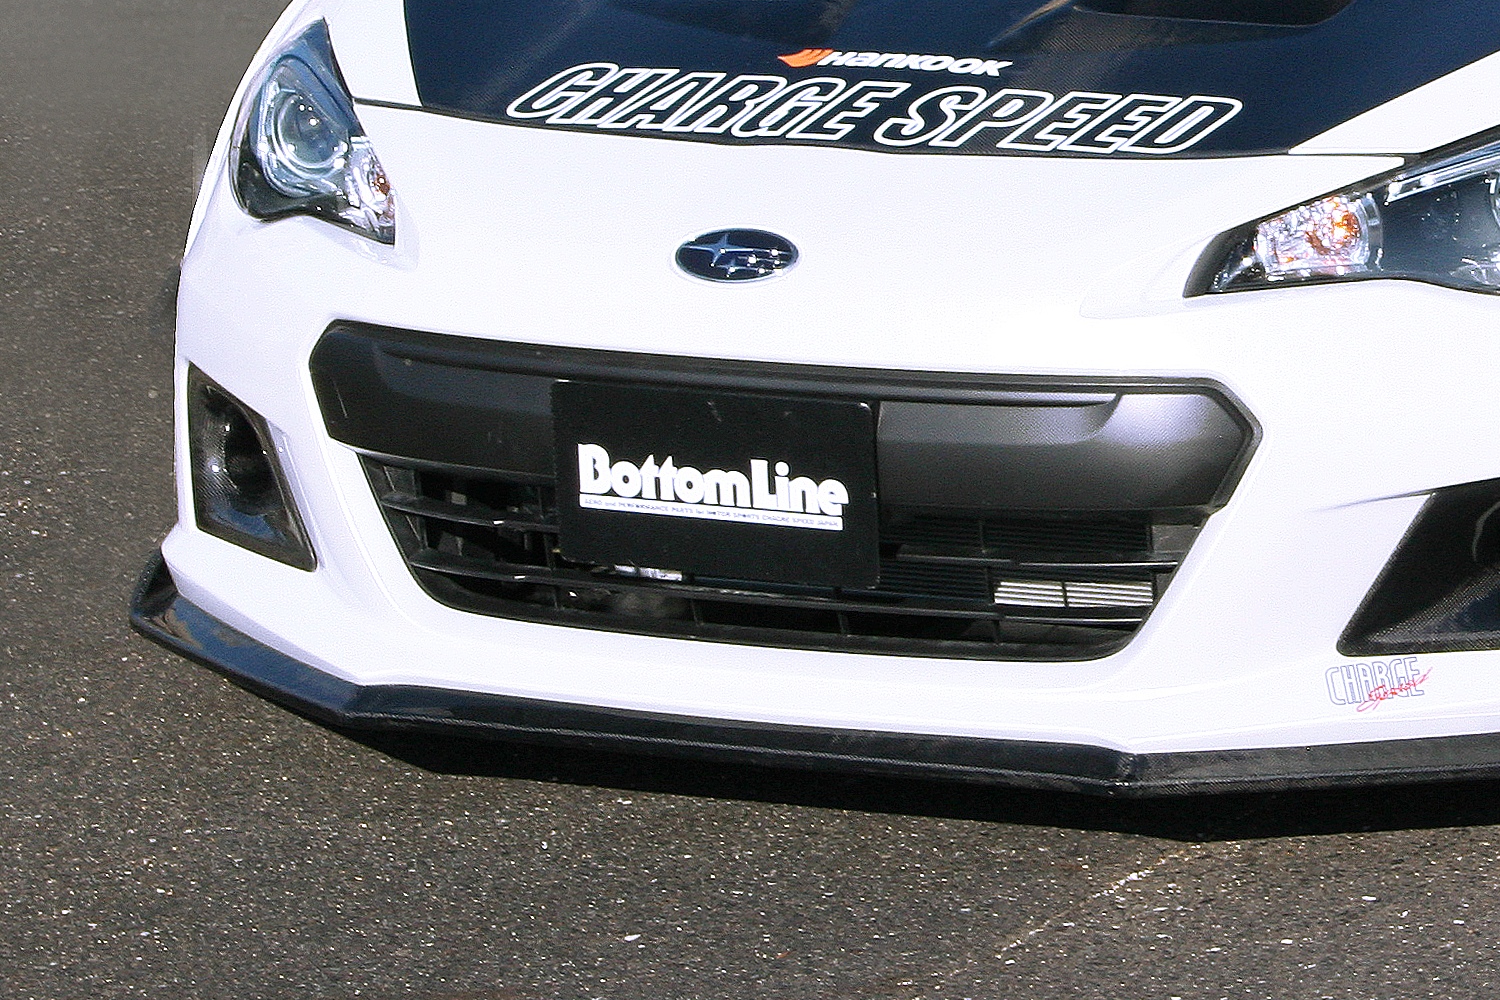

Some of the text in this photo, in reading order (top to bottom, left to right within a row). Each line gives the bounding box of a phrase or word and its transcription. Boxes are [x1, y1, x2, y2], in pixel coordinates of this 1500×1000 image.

[506, 62, 1244, 155] CHARGE SPEED
[1325, 656, 1425, 706] CHARGE
